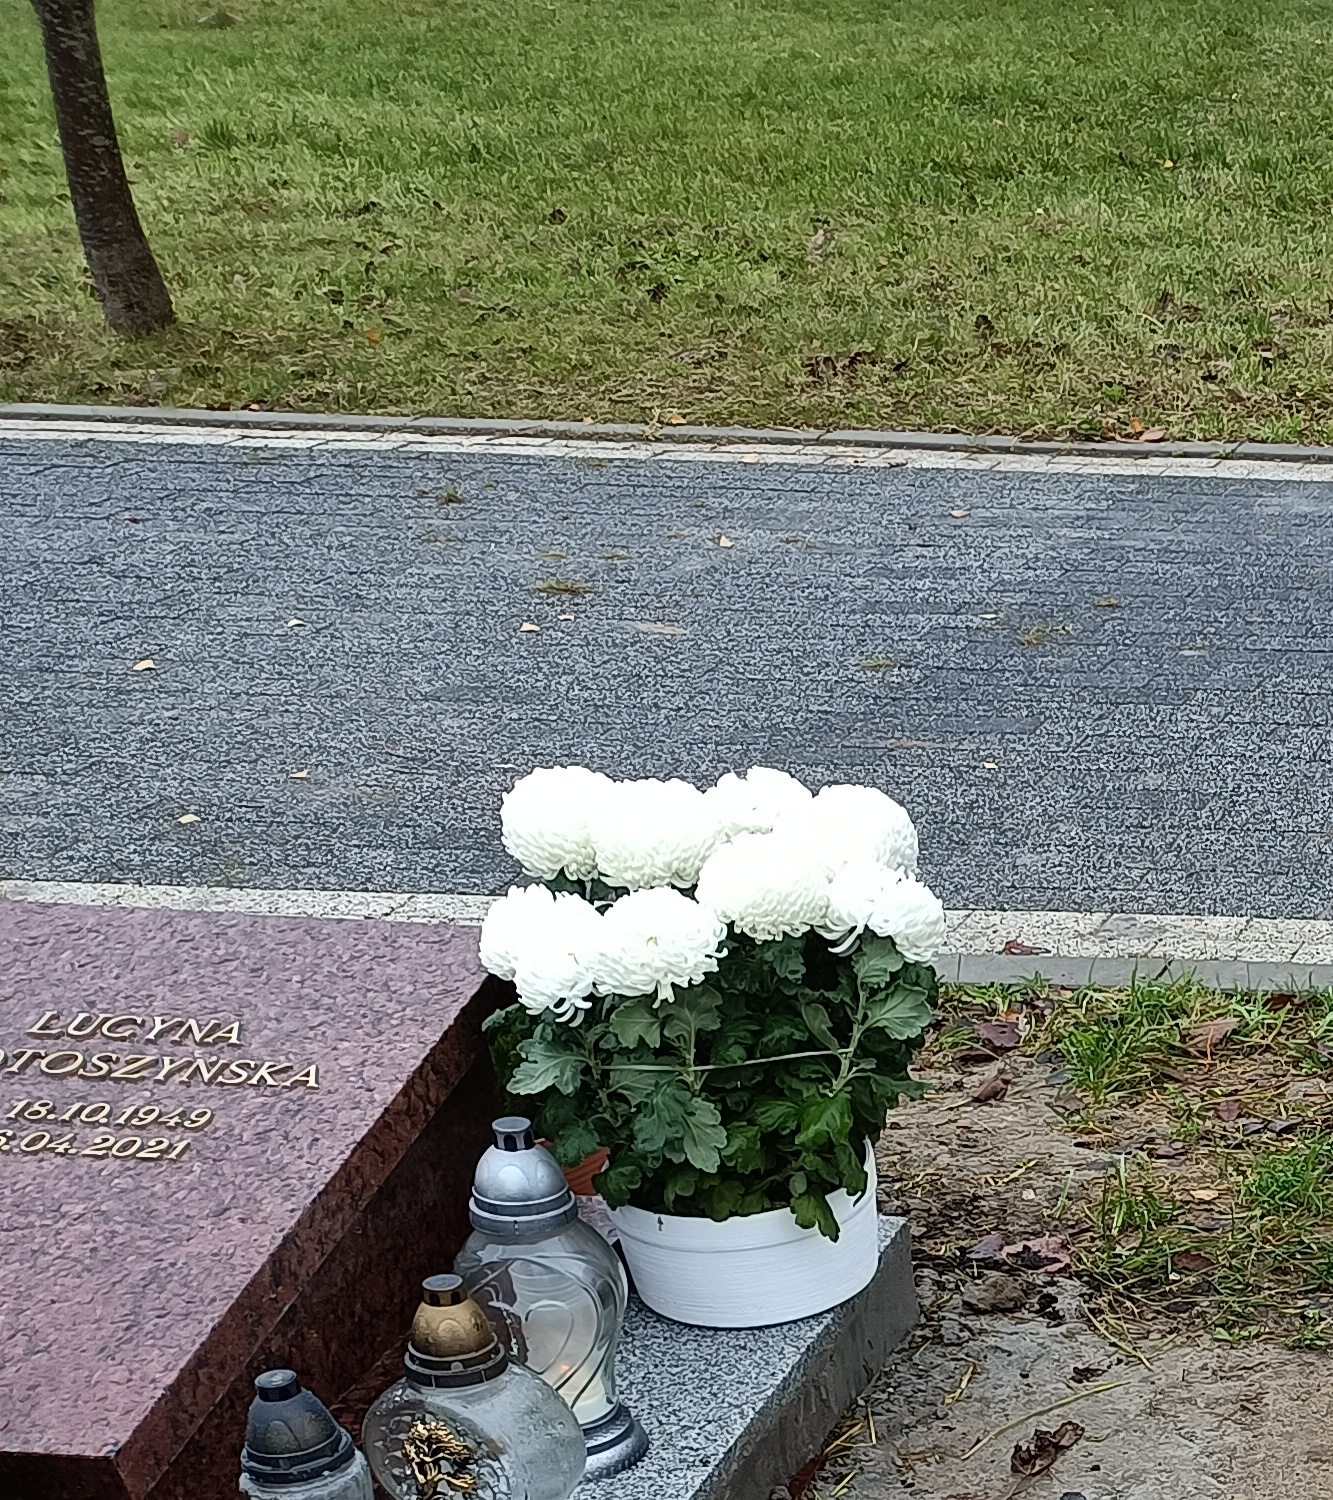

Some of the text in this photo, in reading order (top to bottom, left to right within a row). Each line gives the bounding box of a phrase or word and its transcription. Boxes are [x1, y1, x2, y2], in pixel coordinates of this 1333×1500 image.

[26, 1010, 243, 1045] LUCYNA
[0, 1048, 320, 1089] TOSZYŃSKA
[5, 1099, 214, 1129] 18.10.1949
